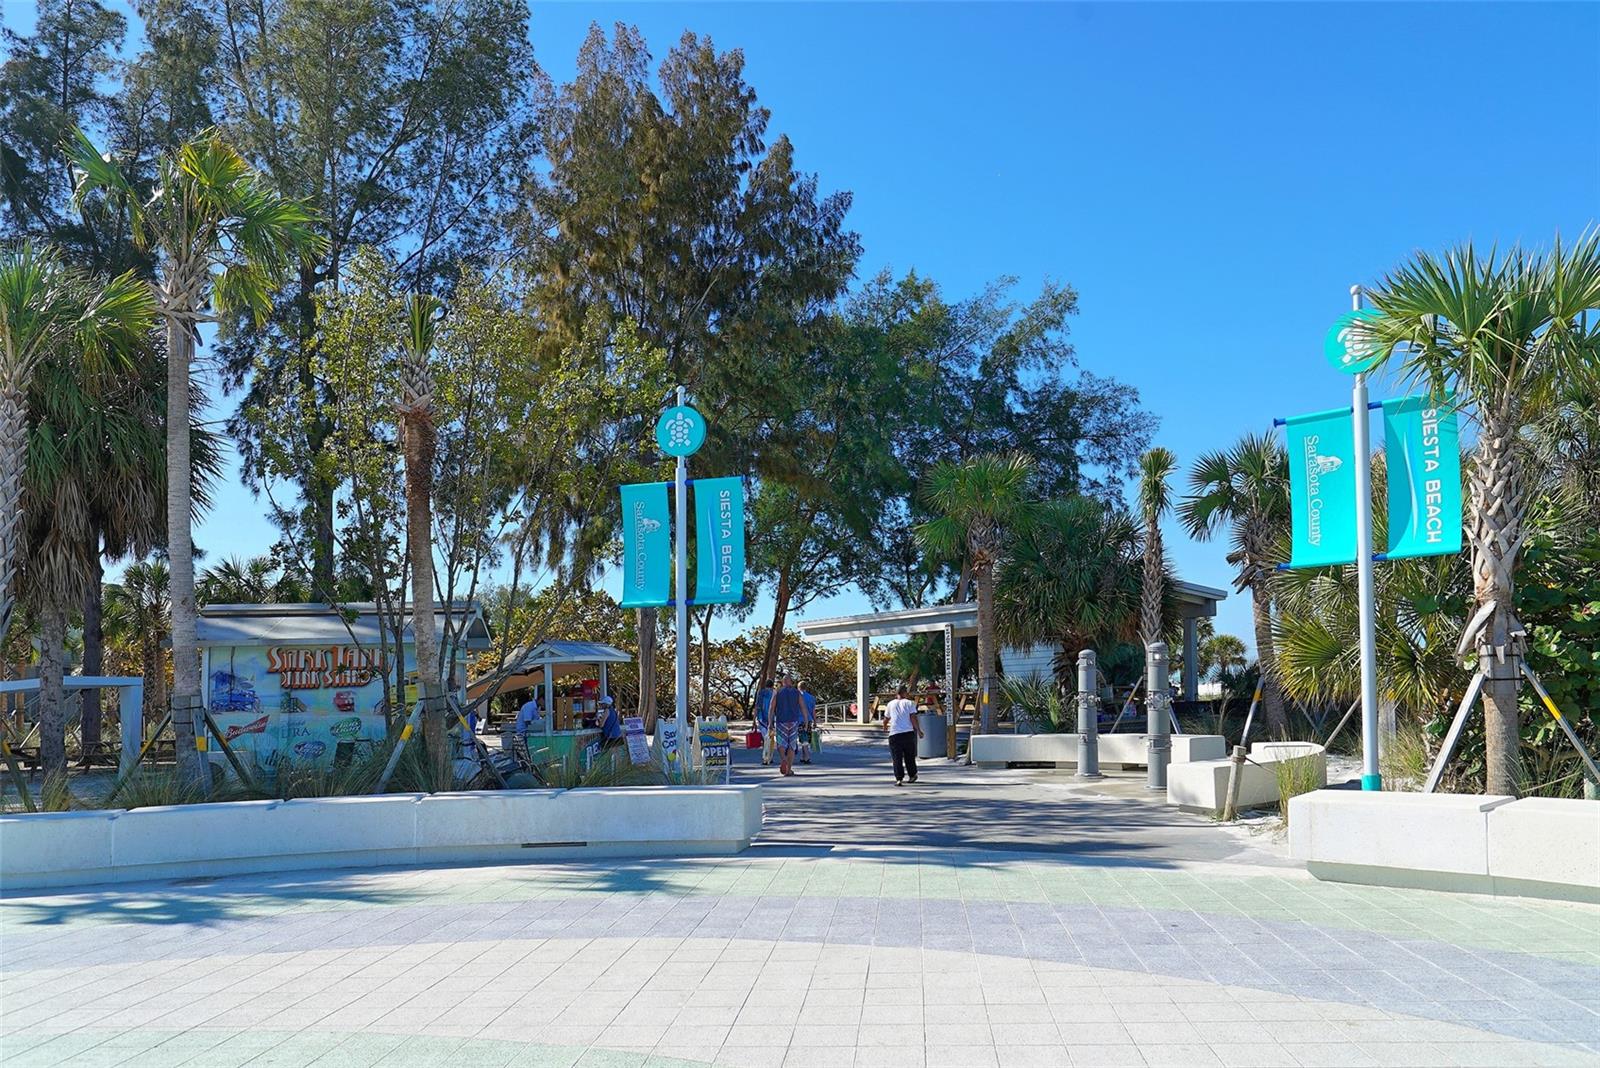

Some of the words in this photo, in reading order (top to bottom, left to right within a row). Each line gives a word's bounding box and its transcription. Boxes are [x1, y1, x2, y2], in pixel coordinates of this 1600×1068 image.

[1421, 408, 1440, 472] SIESTA
[1306, 436, 1321, 495] Sarasota
[635, 502, 646, 550] Sarasota
[719, 490, 731, 539] SIESTA
[1309, 499, 1323, 546] County
[1425, 480, 1442, 543] BEACH
[636, 554, 646, 590] County
[720, 545, 731, 594] BEACH
[703, 746, 729, 758] OPEN
